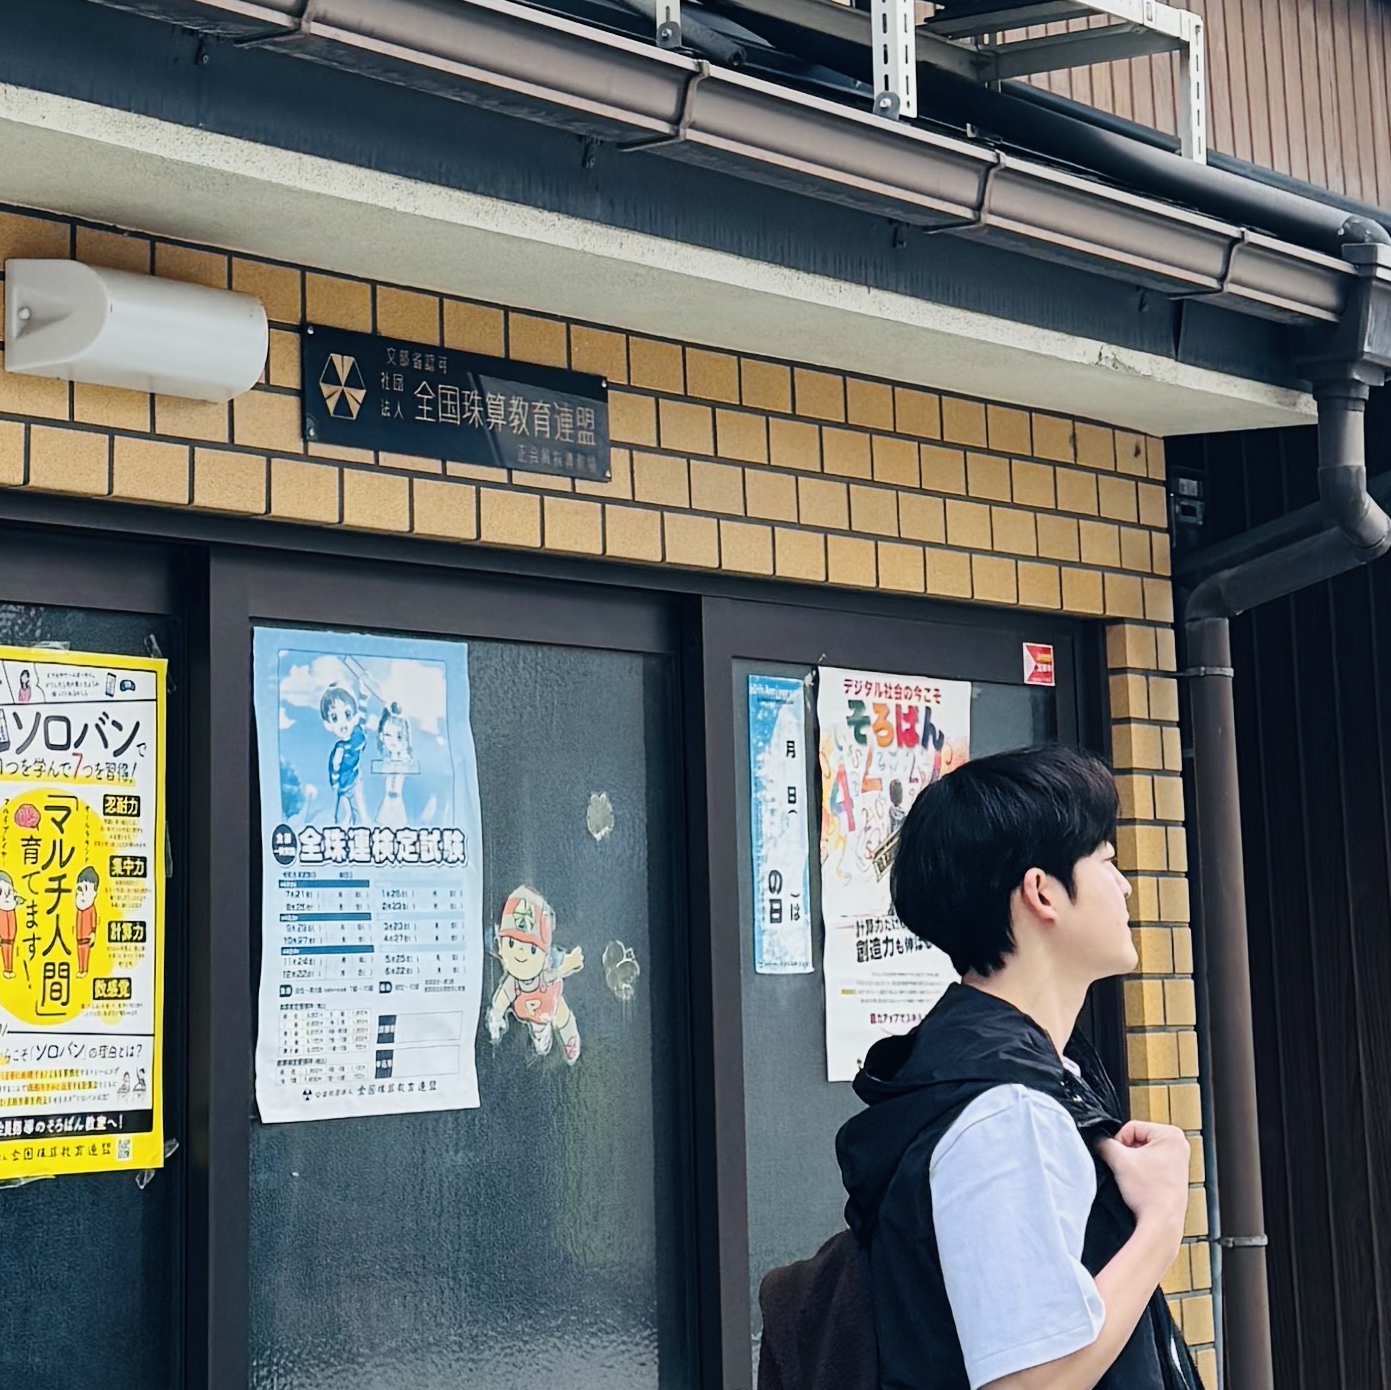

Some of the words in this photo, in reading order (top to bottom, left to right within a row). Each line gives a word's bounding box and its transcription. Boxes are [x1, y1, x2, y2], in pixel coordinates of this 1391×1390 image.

[414, 380, 596, 446] 全国珠算教育連盟
[843, 678, 942, 704] デジタル社会の今こそ
[846, 699, 944, 751] そろばん
[297, 826, 466, 864] 全珠連検定試験
[111, 858, 145, 876] 集中力
[110, 923, 144, 940] 計算力
[525, 998, 542, 1017] P
